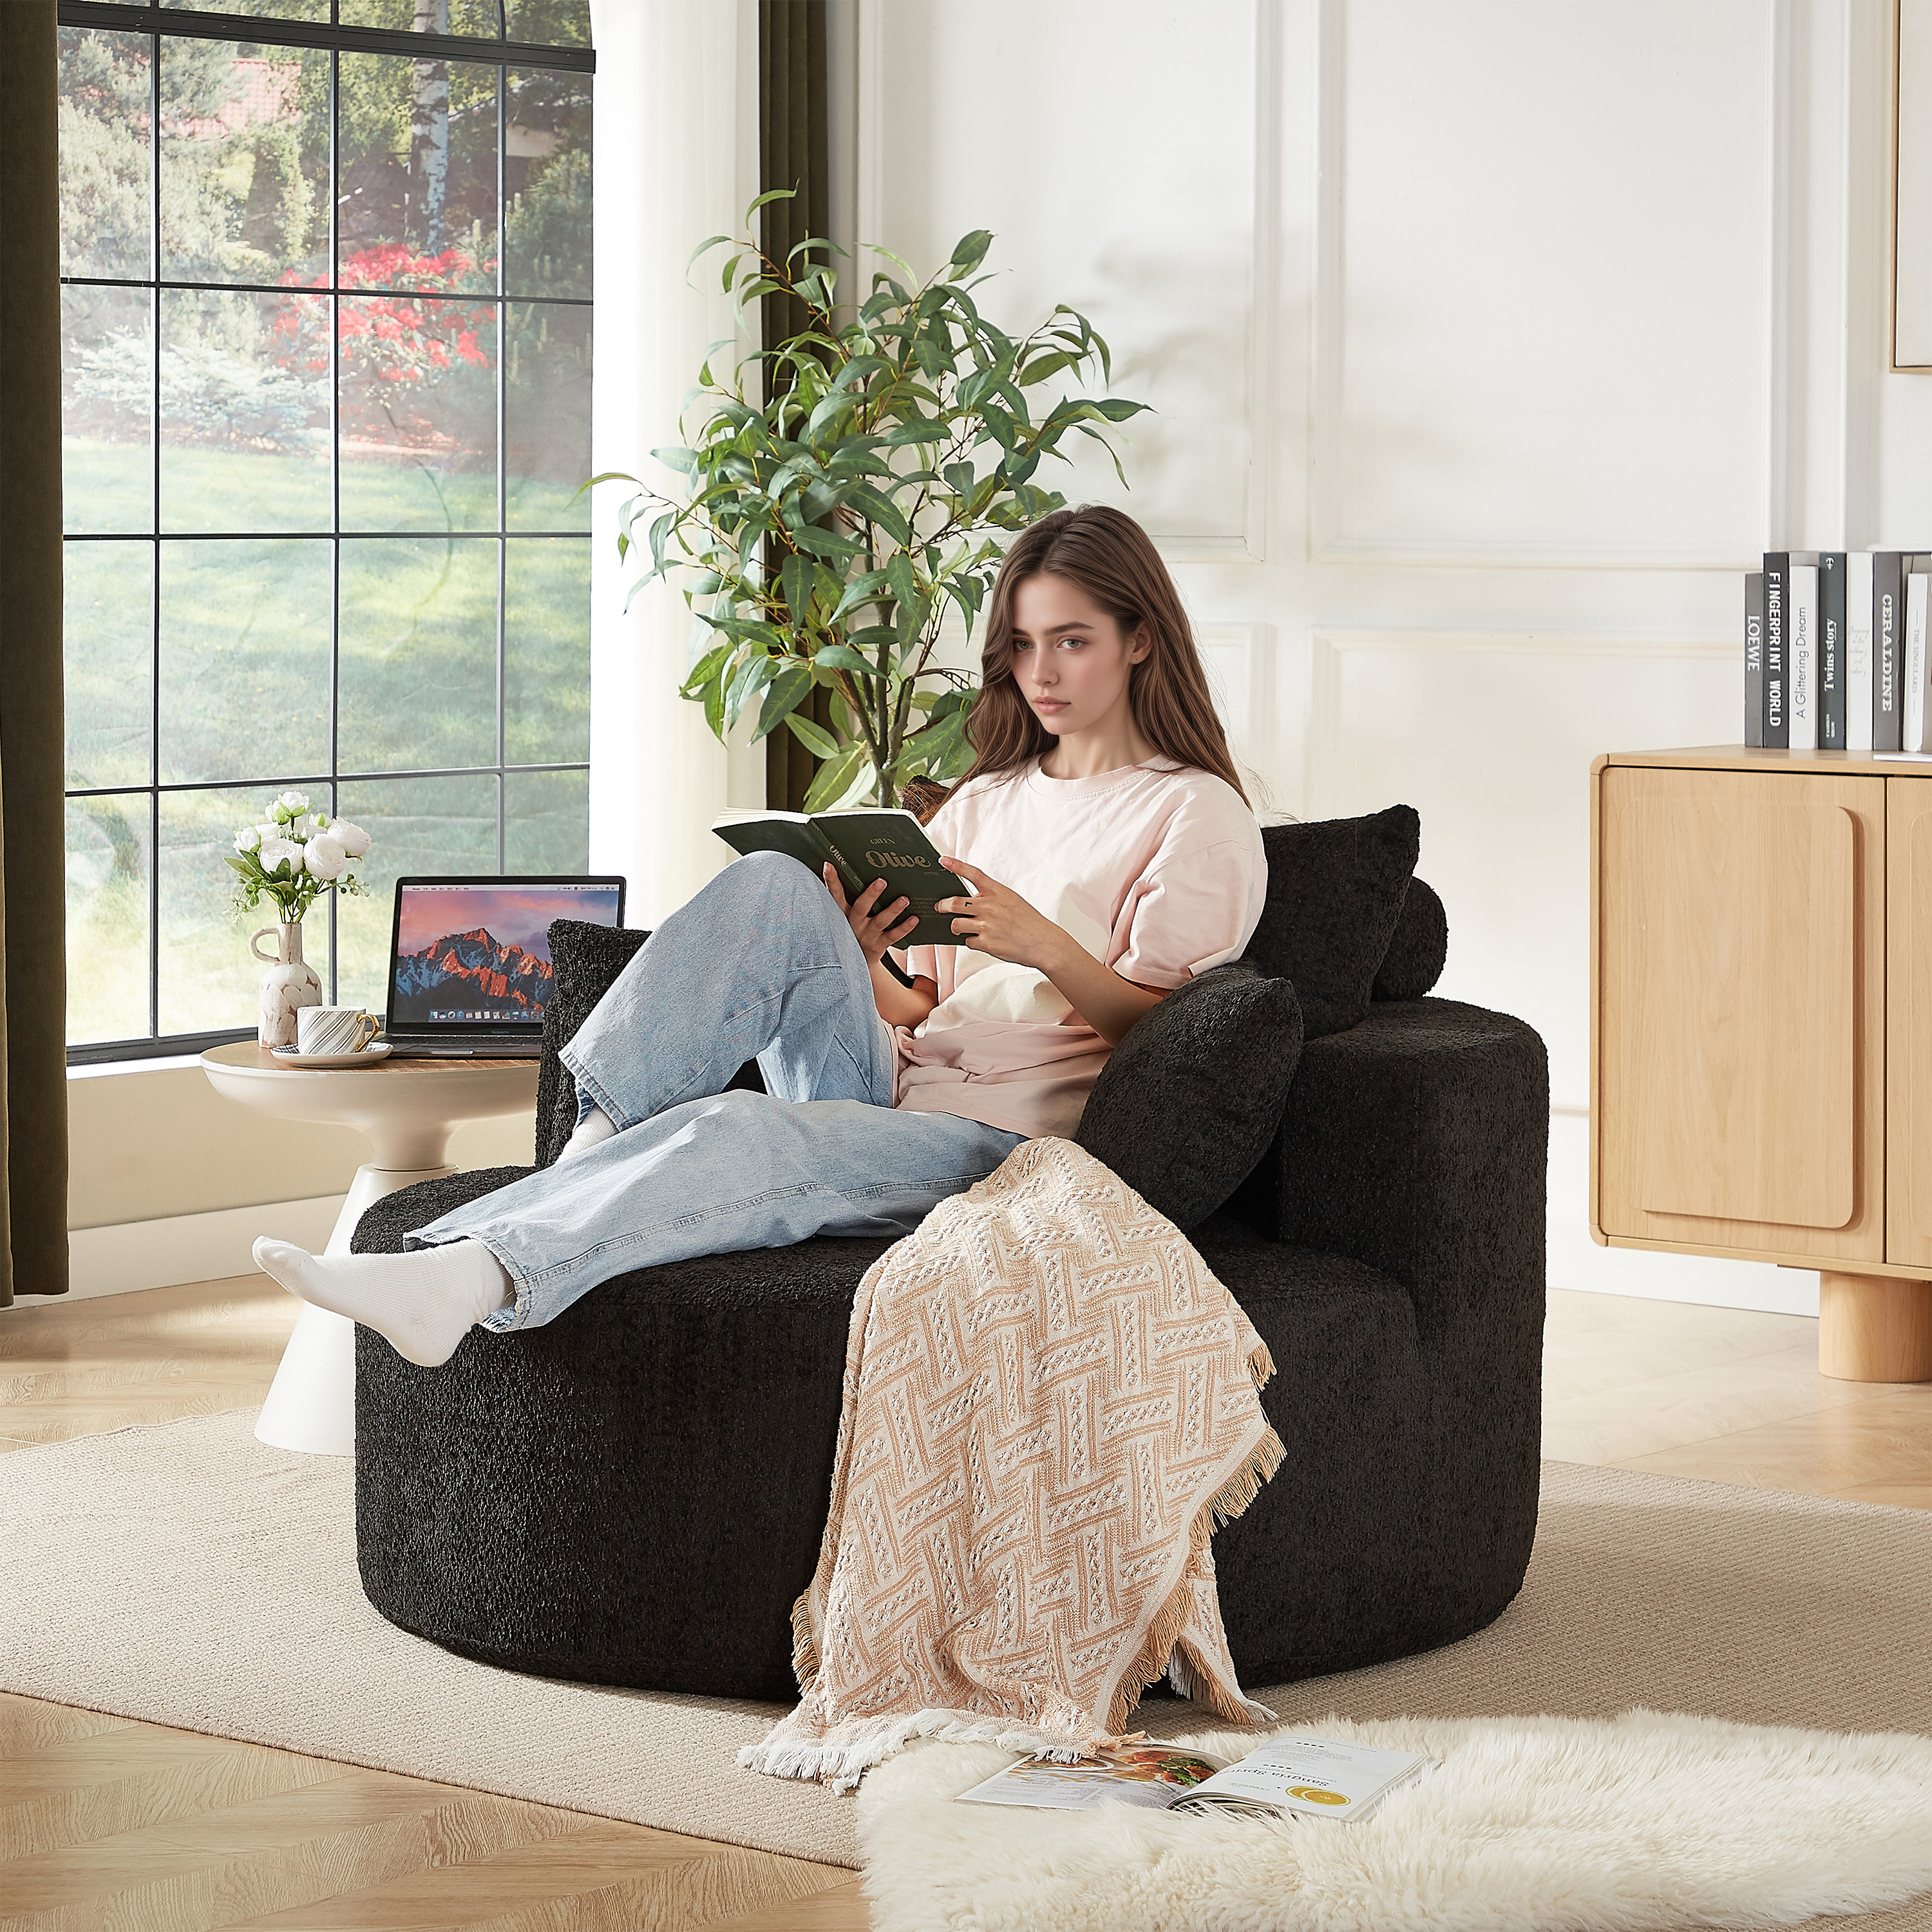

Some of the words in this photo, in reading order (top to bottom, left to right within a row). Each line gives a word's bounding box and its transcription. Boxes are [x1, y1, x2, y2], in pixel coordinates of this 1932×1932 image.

[1769, 572, 1781, 672] FINGERPRINT
[1795, 607, 1806, 646] Dream
[1827, 618, 1837, 650] story
[1748, 615, 1761, 671] LOEWE
[1795, 650, 1809, 705] Glittering
[1824, 652, 1835, 692] Twins
[1769, 680, 1782, 726] WORLD
[1796, 708, 1806, 719] A
[865, 850, 931, 867] Olive
[853, 876, 865, 889] PITTE
[1271, 1772, 1329, 1786] Sangria
